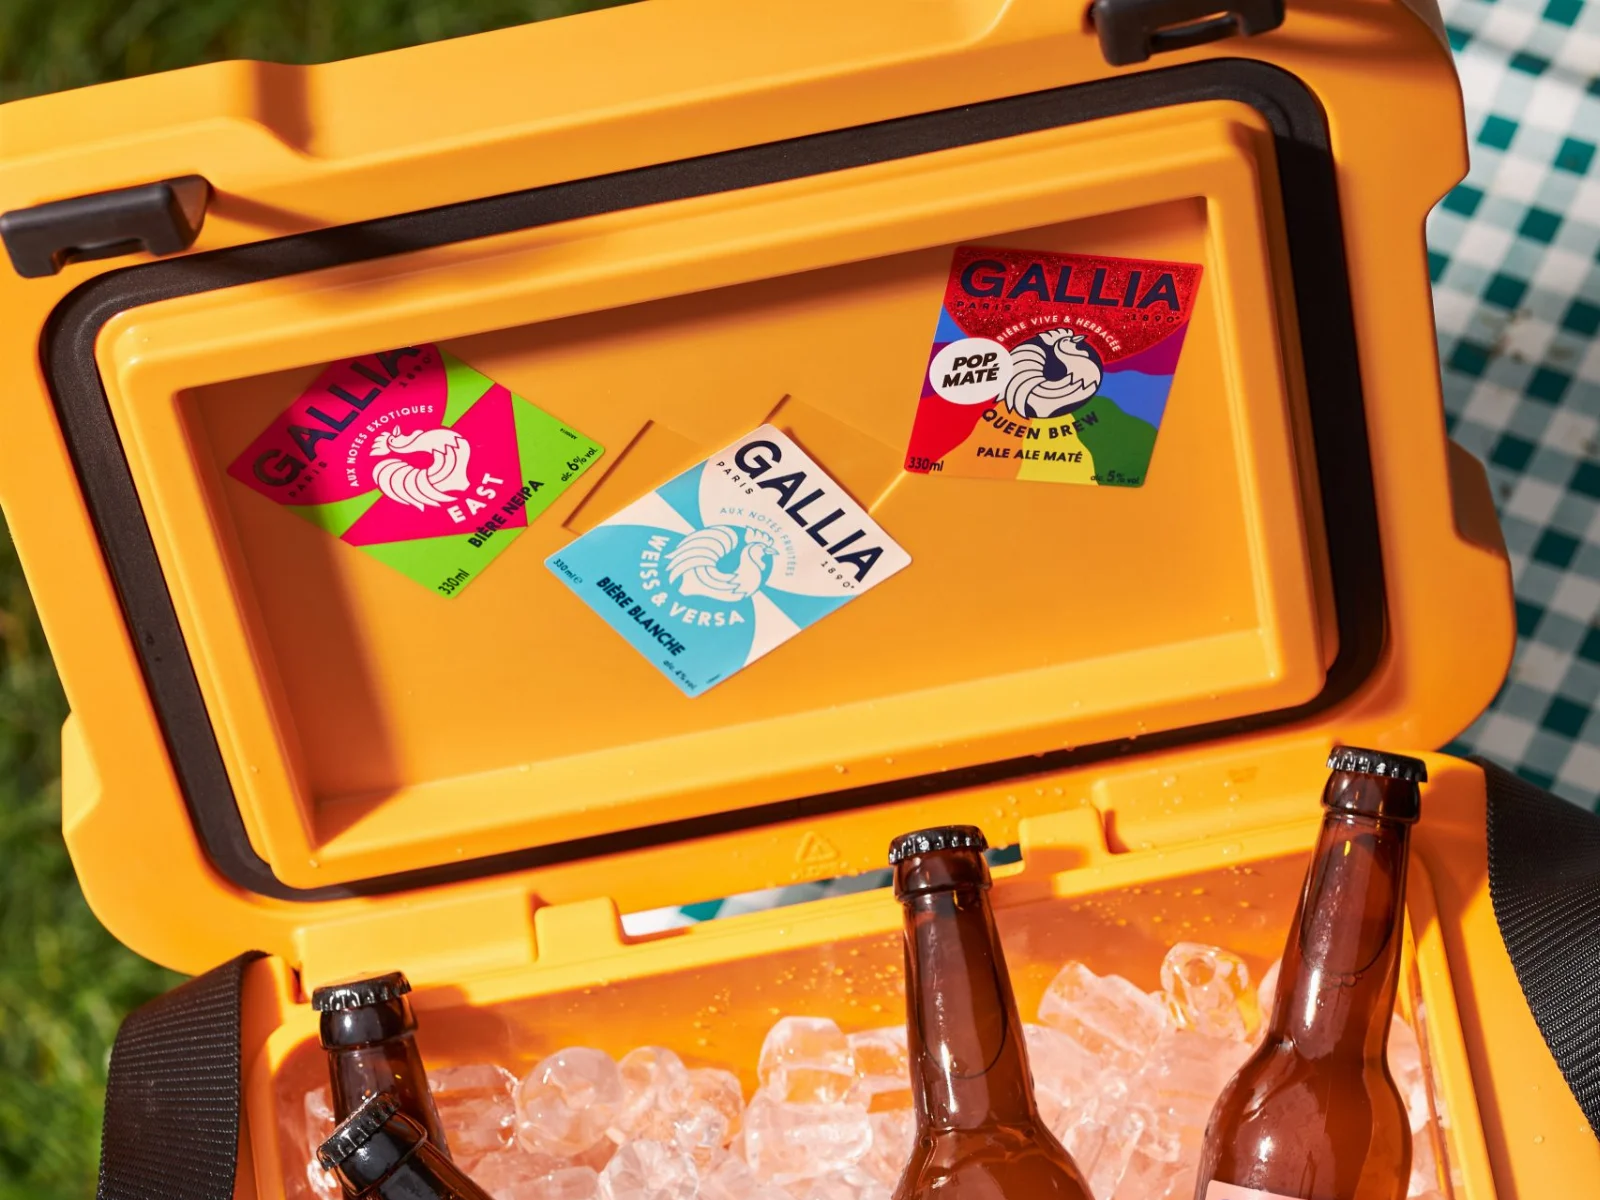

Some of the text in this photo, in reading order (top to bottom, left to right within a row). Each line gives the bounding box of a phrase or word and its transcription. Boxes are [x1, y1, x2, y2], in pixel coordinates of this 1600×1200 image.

[960, 259, 1181, 312] GALLIA
[956, 301, 1012, 312] PARIS
[996, 315, 1122, 353] BIÈRE VIVE & HERBACÉE
[942, 363, 1000, 388] MATÉ
[252, 346, 421, 487] GALLIA
[981, 408, 1099, 440] QUEEN BREW
[346, 405, 434, 487] AUX NOTES EXOTIQUES
[566, 456, 587, 471] 6%
[908, 456, 944, 471] 330ml
[976, 447, 1083, 463] PALE ALE MATÉ
[289, 461, 328, 497] PARIS
[716, 461, 754, 495] PARIS
[447, 473, 504, 524] EAST
[467, 479, 545, 549] BIÈRE NEIPA
[734, 440, 884, 583] GALLIA
[720, 507, 797, 577] AUX NOTES FRUITÉES
[438, 568, 470, 595] 330ml
[640, 534, 746, 627] WEISS & VERSA
[596, 576, 686, 656] BIÈRE BLANCHE
